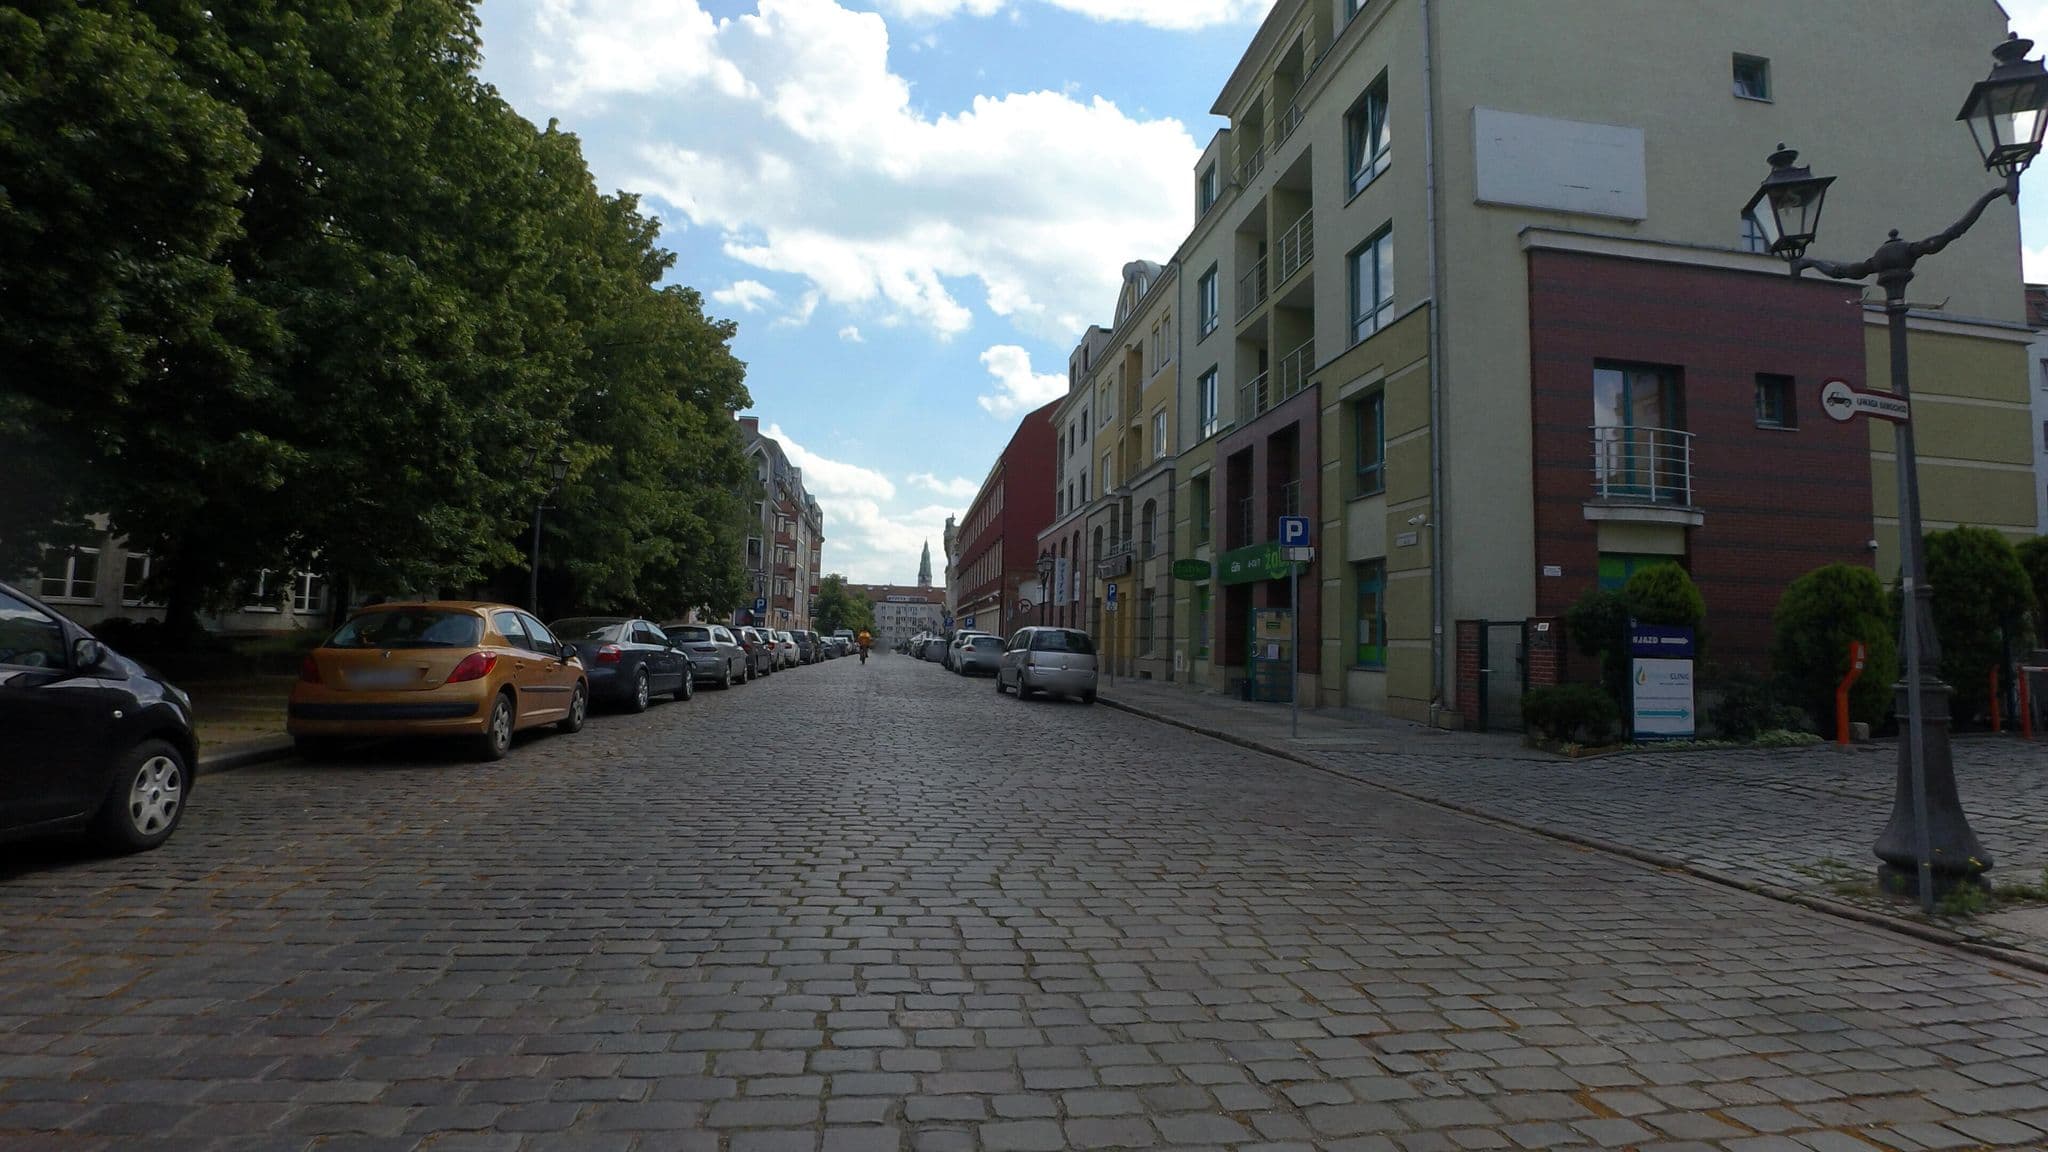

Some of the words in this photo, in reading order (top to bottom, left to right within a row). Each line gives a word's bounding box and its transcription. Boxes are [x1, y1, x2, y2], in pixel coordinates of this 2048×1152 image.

[1286, 520, 1303, 543] P
[1109, 584, 1116, 596] P
[756, 598, 765, 609] P
